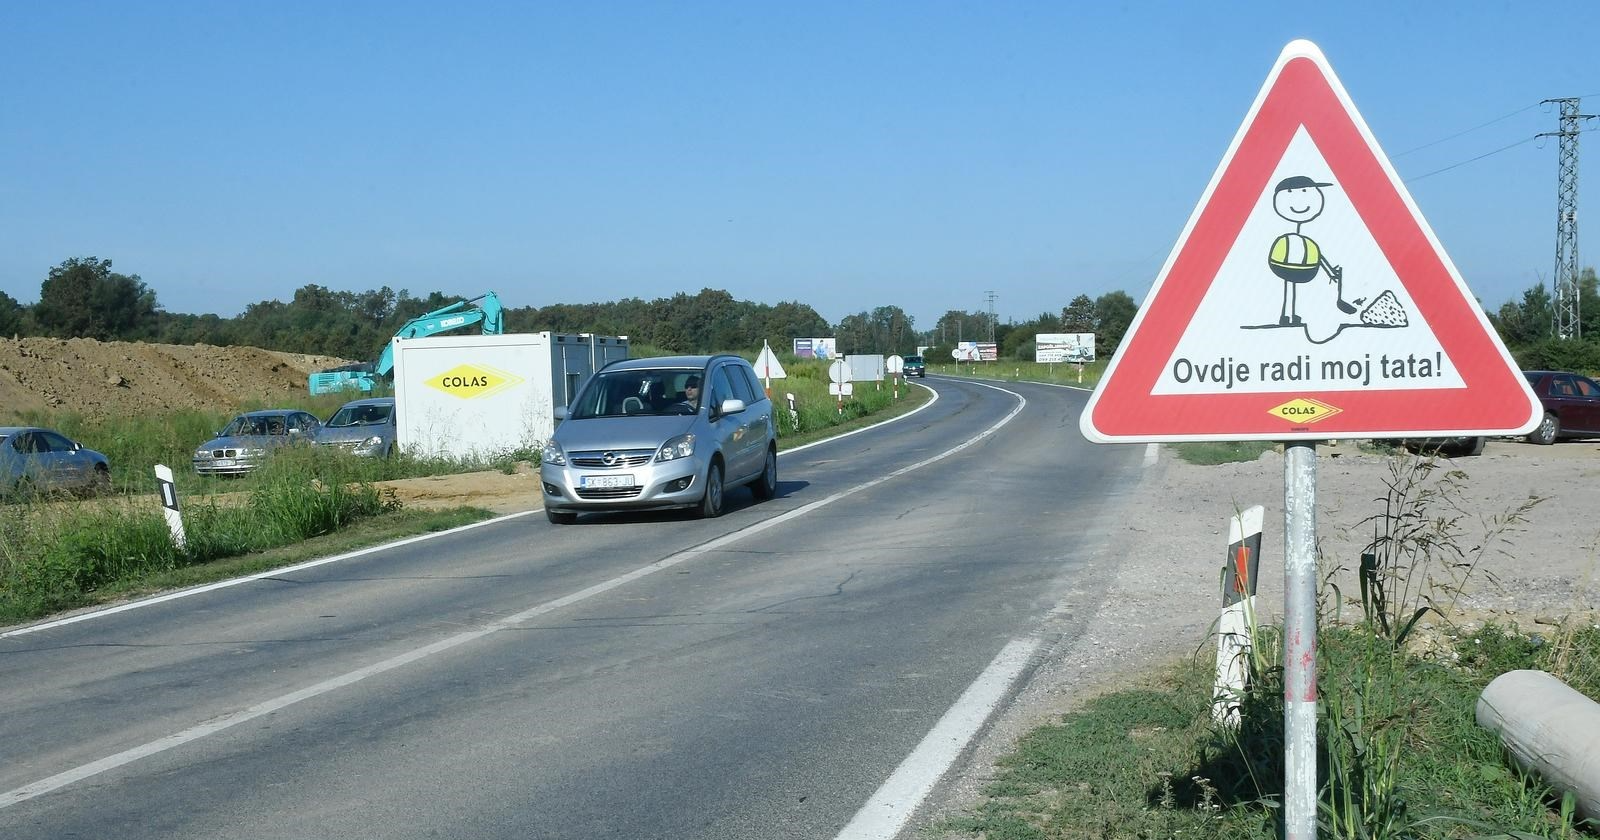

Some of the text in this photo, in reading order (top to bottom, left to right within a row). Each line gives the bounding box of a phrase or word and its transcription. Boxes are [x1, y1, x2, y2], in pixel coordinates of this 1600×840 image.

[1173, 351, 1442, 389] Ovdje radi moj tata!
[442, 376, 488, 388] COLAS
[1281, 406, 1316, 415] COLAS
